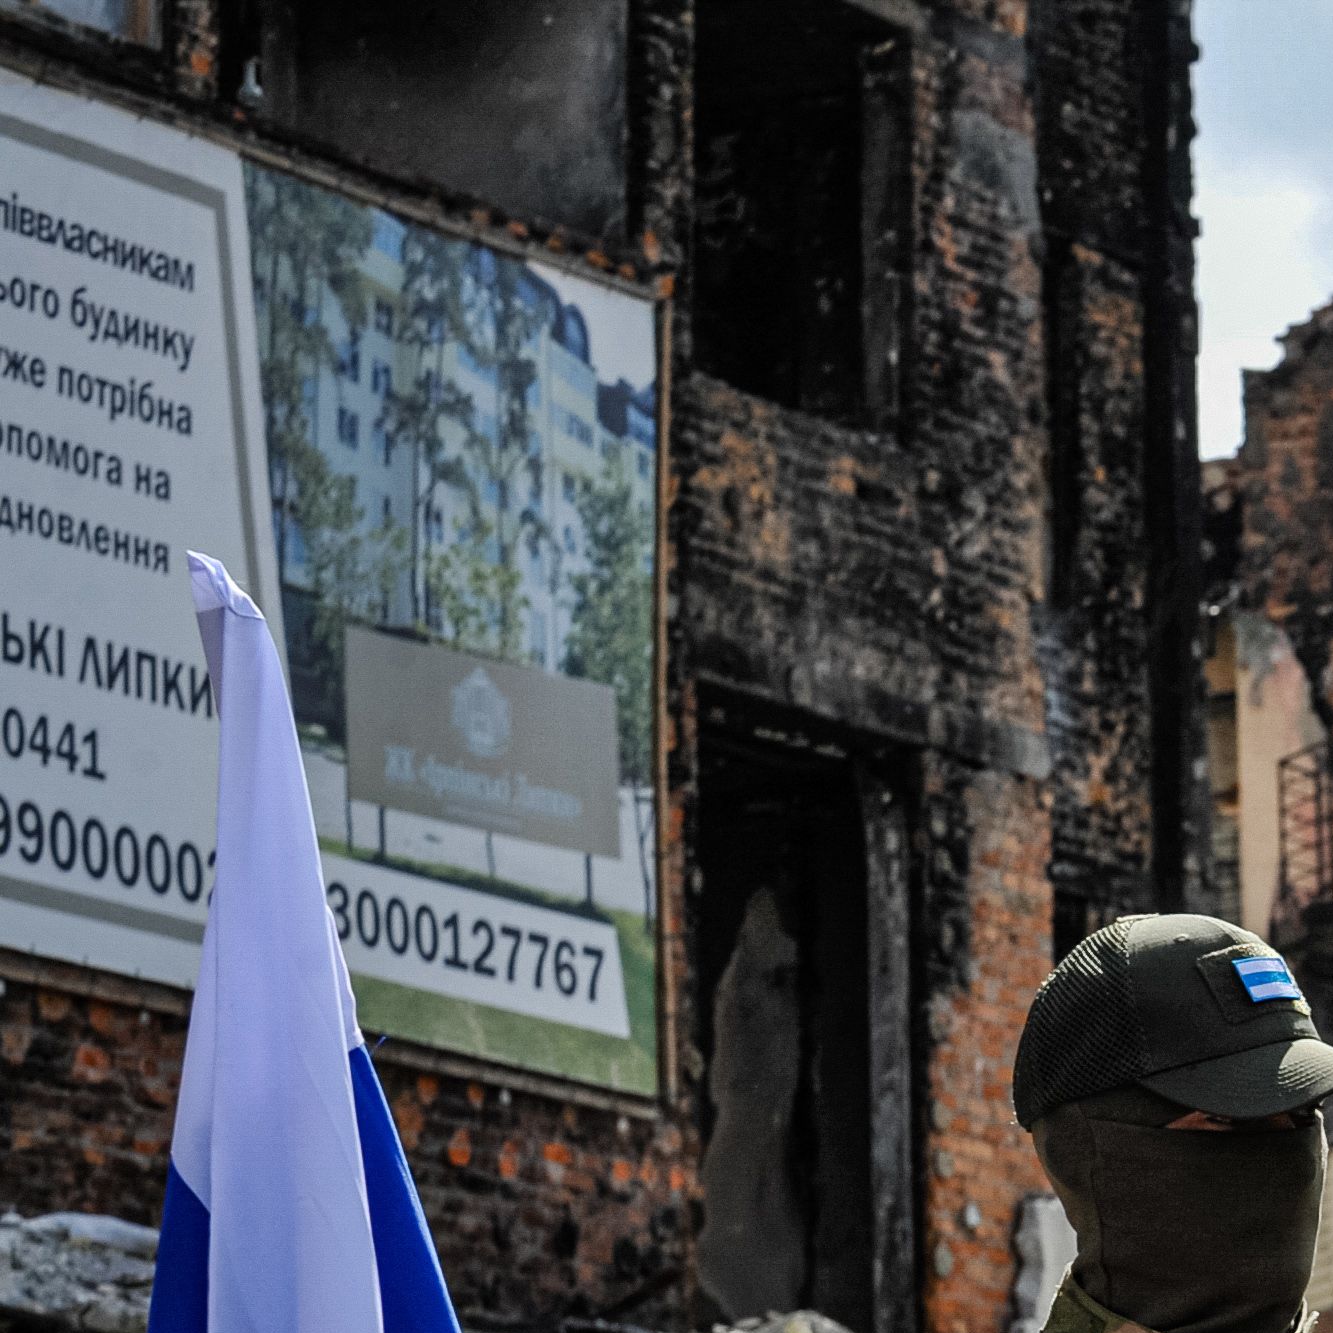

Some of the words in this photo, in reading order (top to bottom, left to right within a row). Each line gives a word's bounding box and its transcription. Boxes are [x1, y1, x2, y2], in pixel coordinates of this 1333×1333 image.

[70, 284, 194, 372] будинку
[57, 366, 192, 435] потрібна
[0, 420, 122, 486] помога
[135, 463, 170, 501] на
[79, 636, 214, 719] ЛИПКИ
[2, 707, 106, 781] 0441
